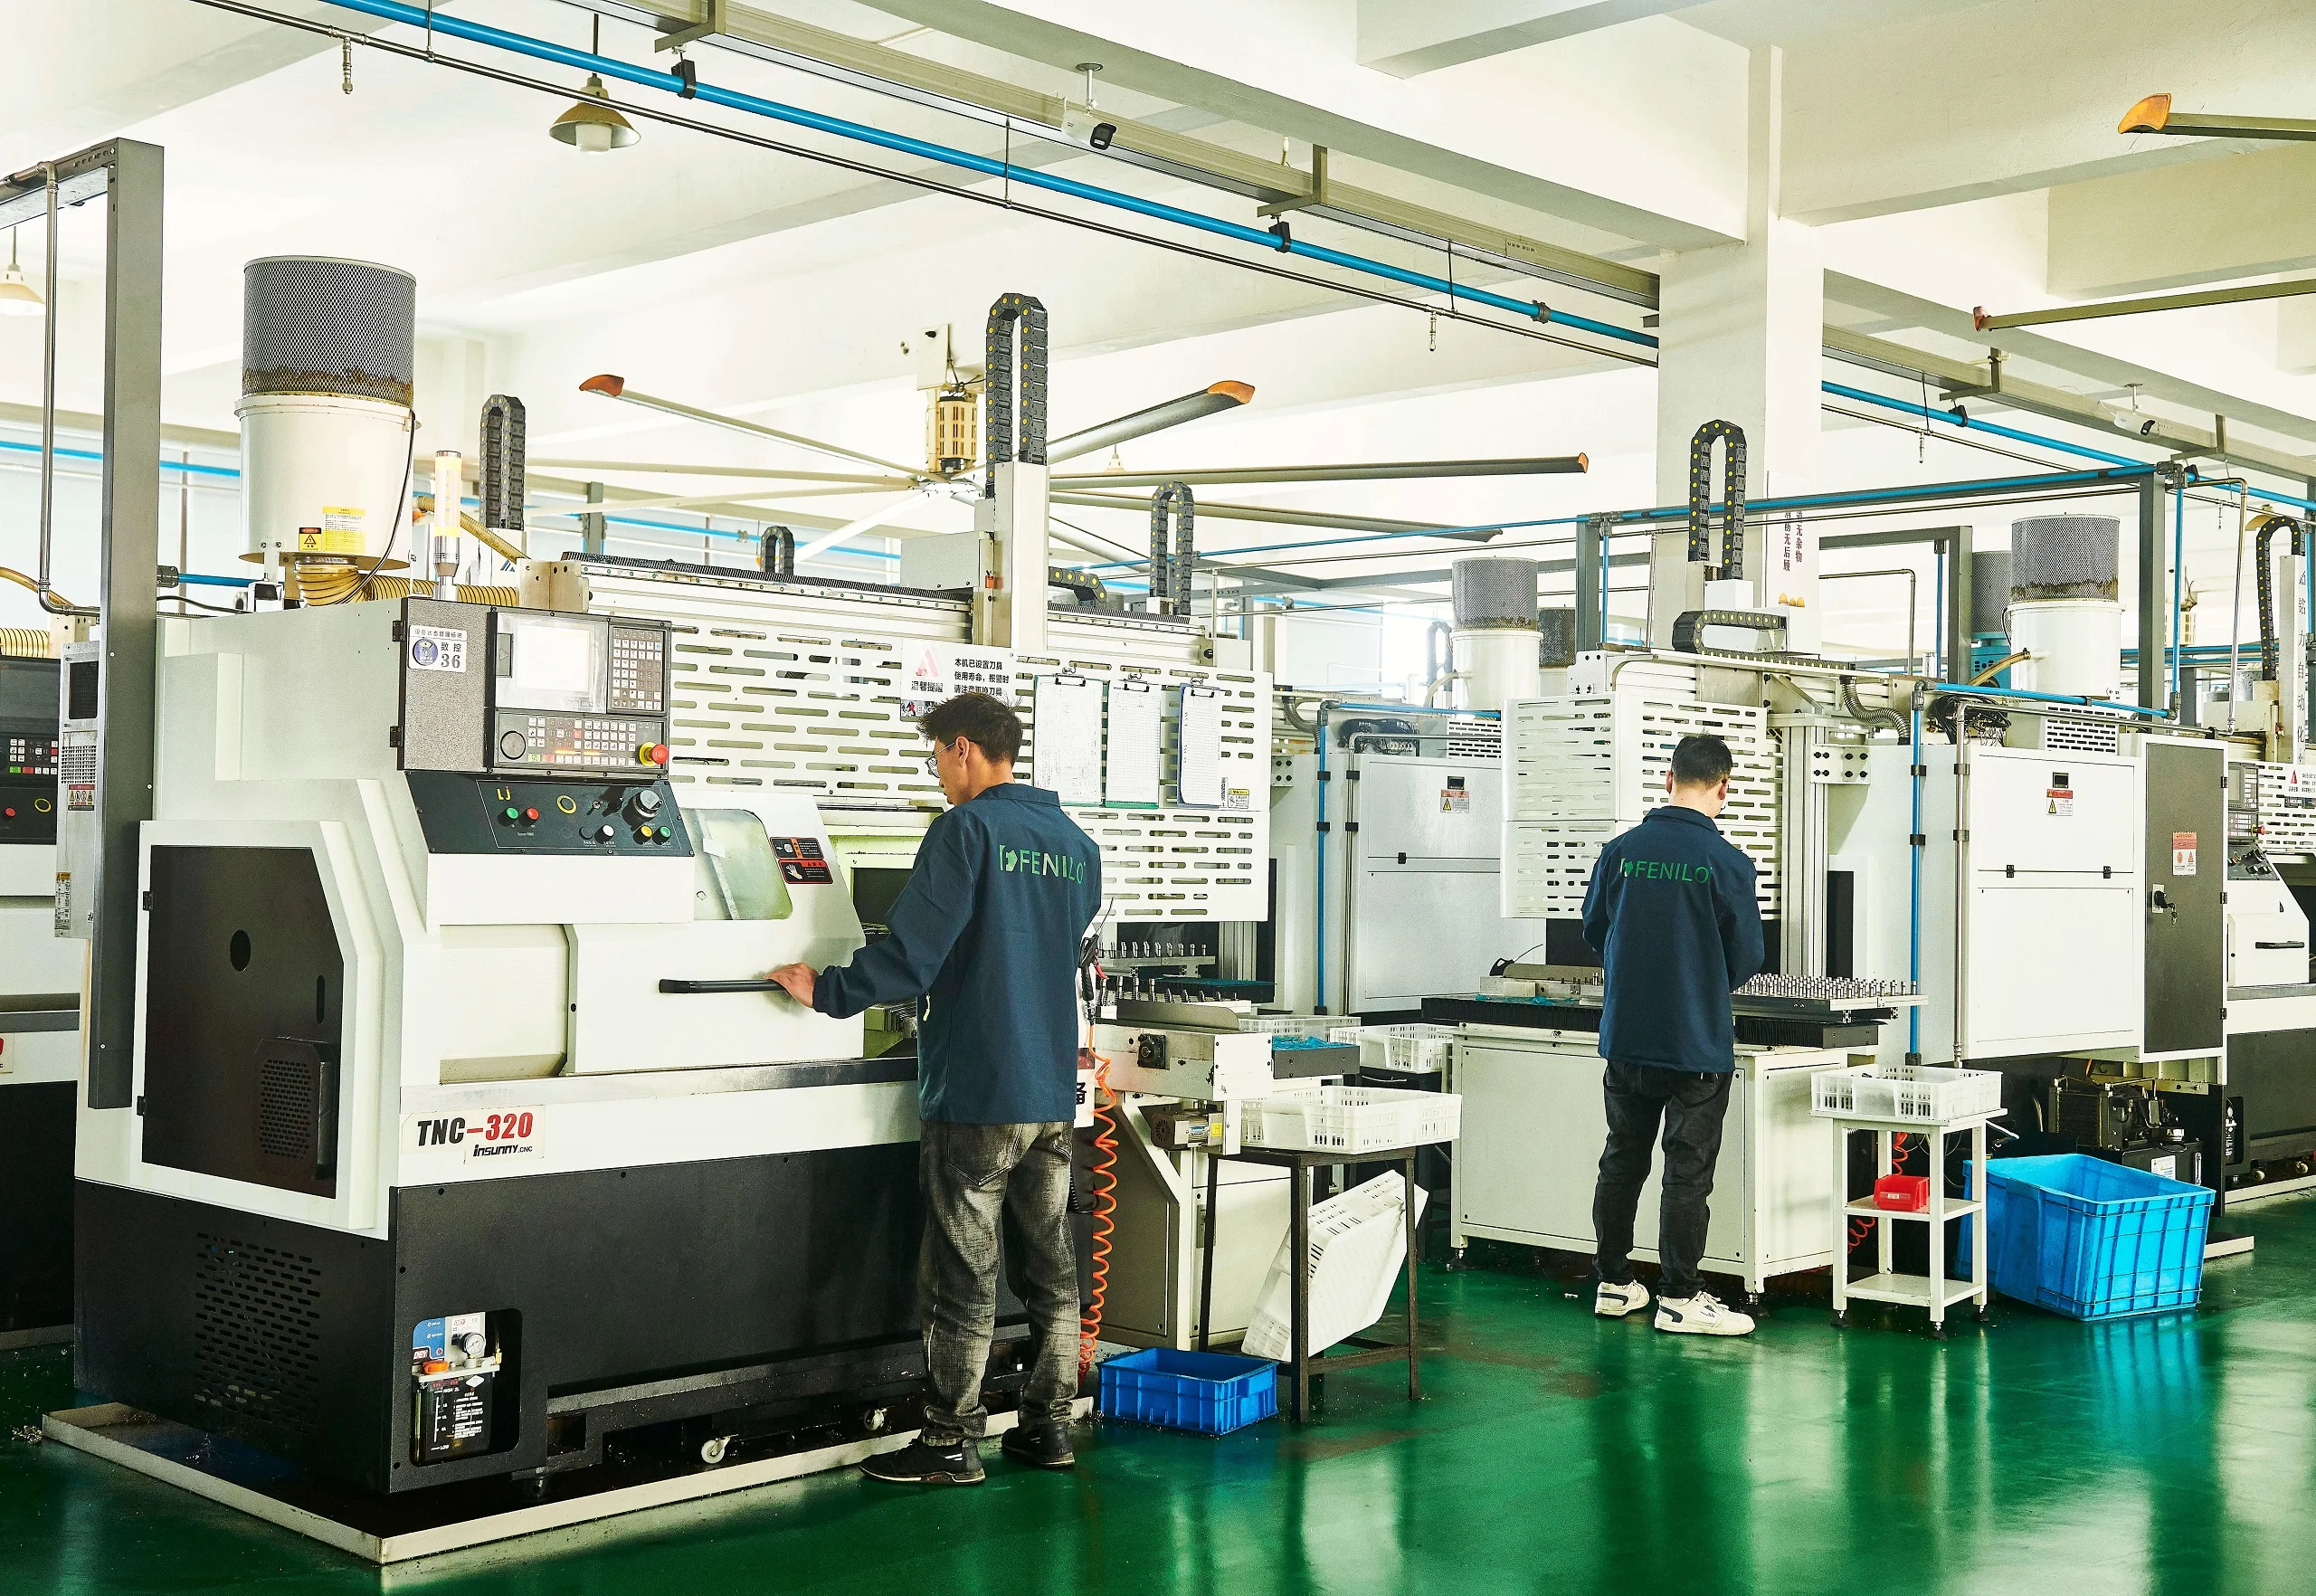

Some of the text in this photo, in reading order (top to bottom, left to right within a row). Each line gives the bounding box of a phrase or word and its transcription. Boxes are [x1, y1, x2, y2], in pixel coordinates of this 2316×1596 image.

[441, 653, 461, 669] 36
[954, 658, 1003, 670] 本机已设置刀具
[911, 680, 944, 693] 温馨提醒
[1020, 849, 1084, 885] FENILO
[1635, 860, 1710, 883] FENILO
[417, 1111, 534, 1146] TNC-320
